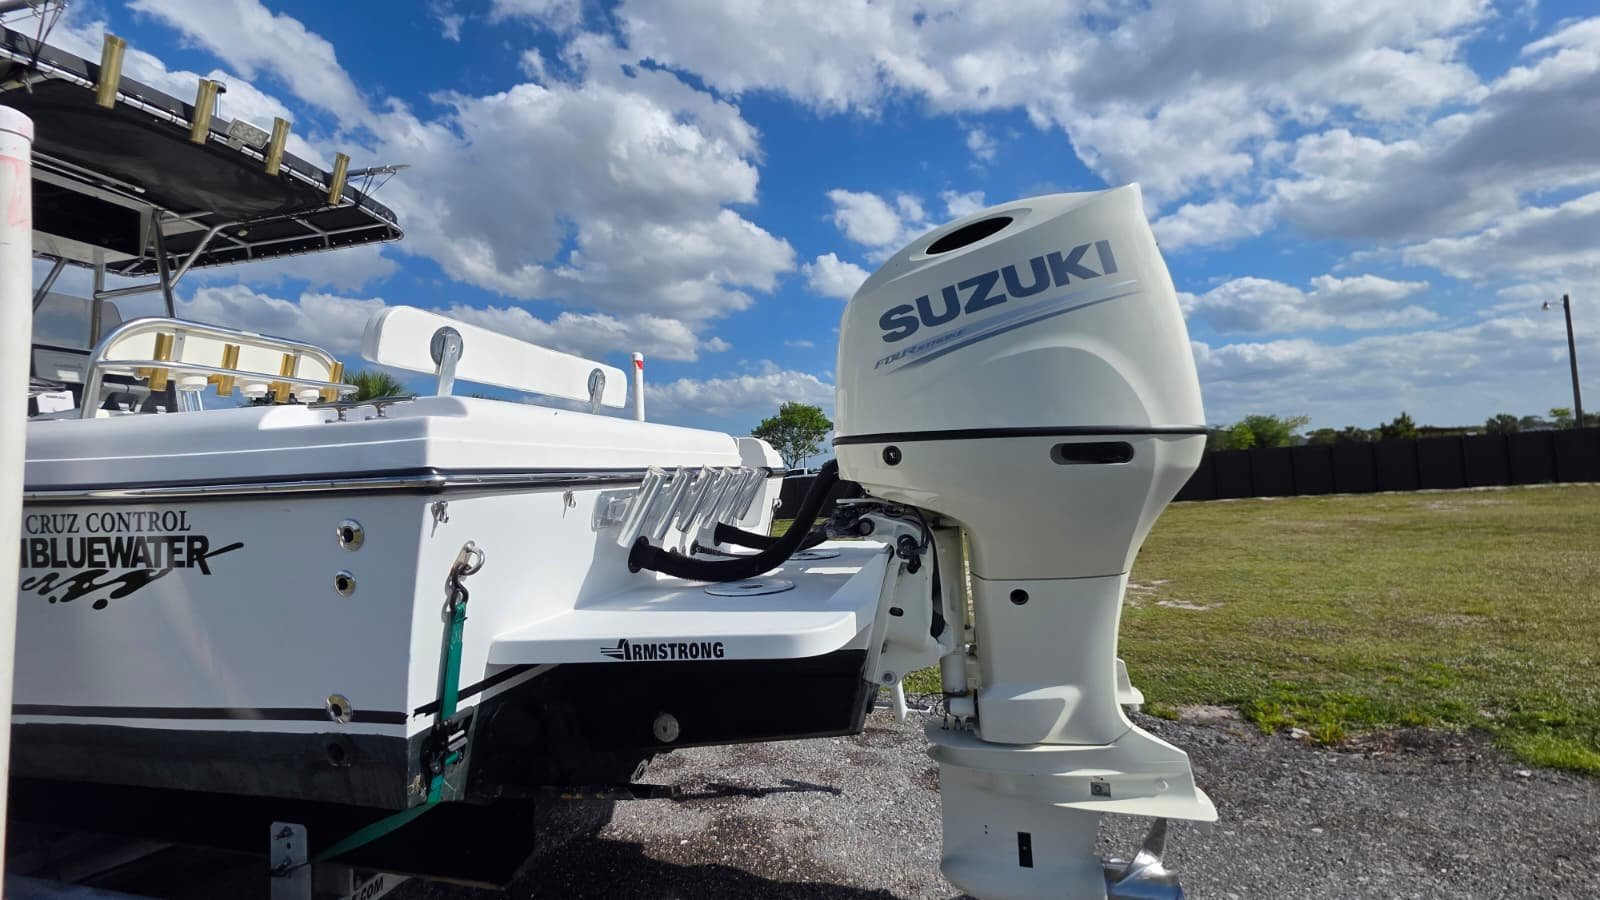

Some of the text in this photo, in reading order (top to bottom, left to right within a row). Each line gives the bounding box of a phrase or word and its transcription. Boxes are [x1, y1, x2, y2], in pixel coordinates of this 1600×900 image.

[879, 239, 1119, 343] SUZUKI
[25, 510, 191, 534] CRUZ CONTROL
[616, 638, 725, 661] ARMSTRONG
